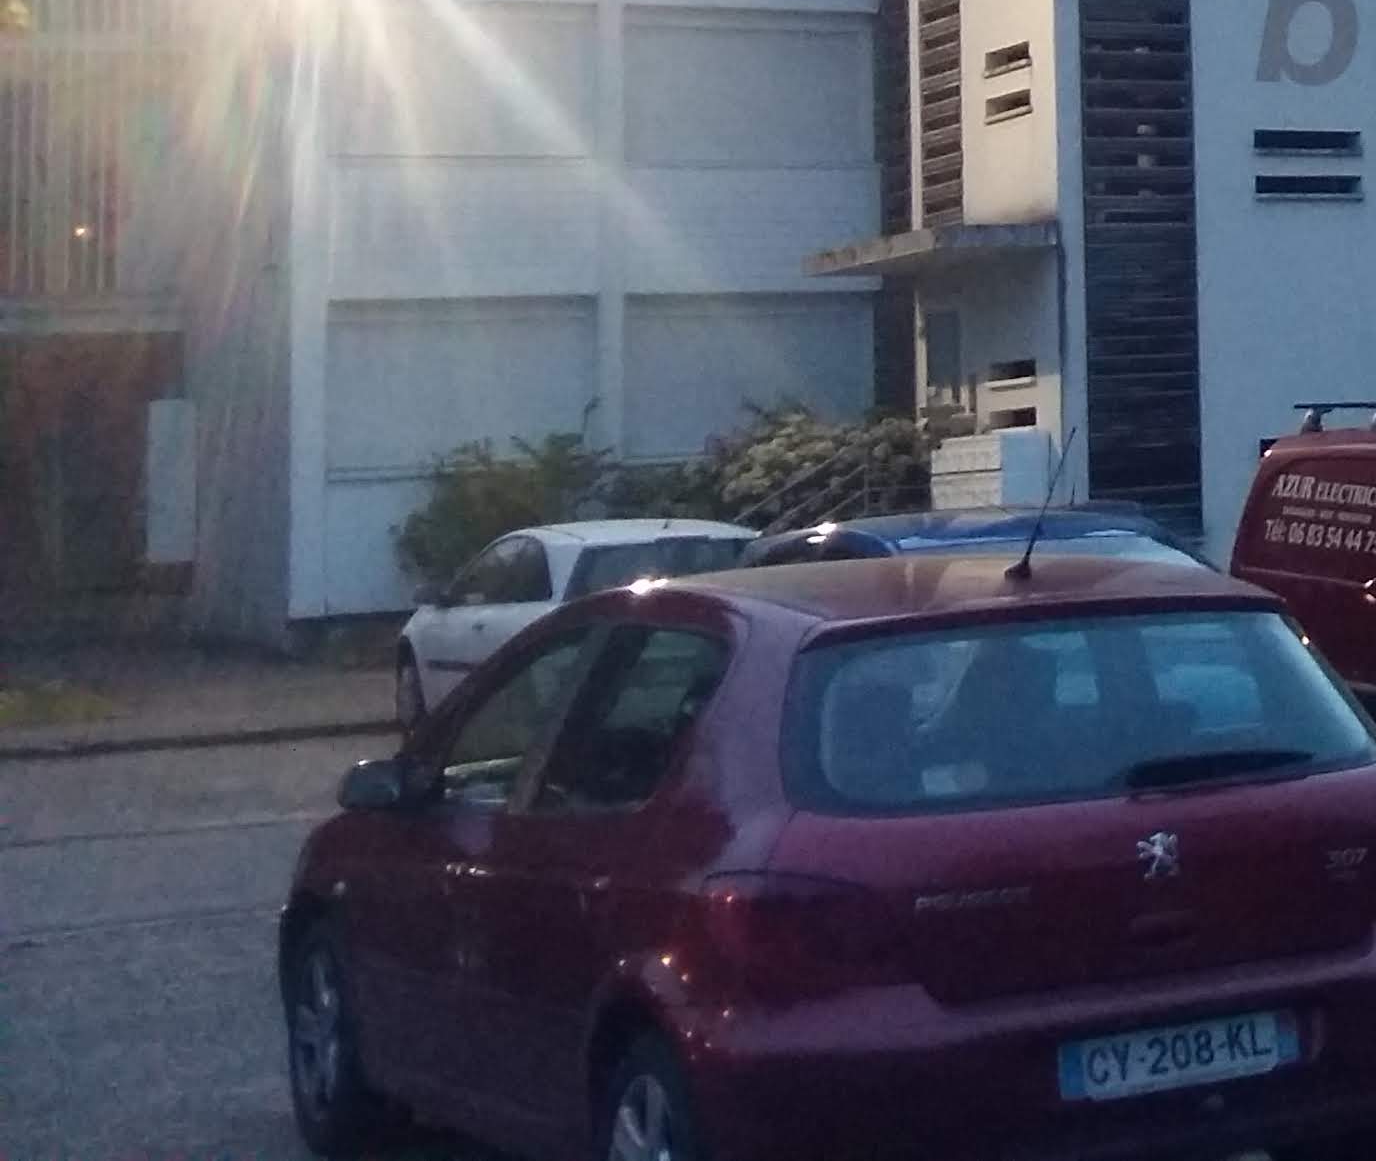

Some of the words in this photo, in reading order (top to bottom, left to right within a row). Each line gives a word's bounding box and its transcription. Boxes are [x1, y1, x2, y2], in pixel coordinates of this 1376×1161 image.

[1271, 474, 1316, 500] AZUR
[1344, 529, 1363, 551] 44
[1087, 1020, 1272, 1086] CY-208-KL
